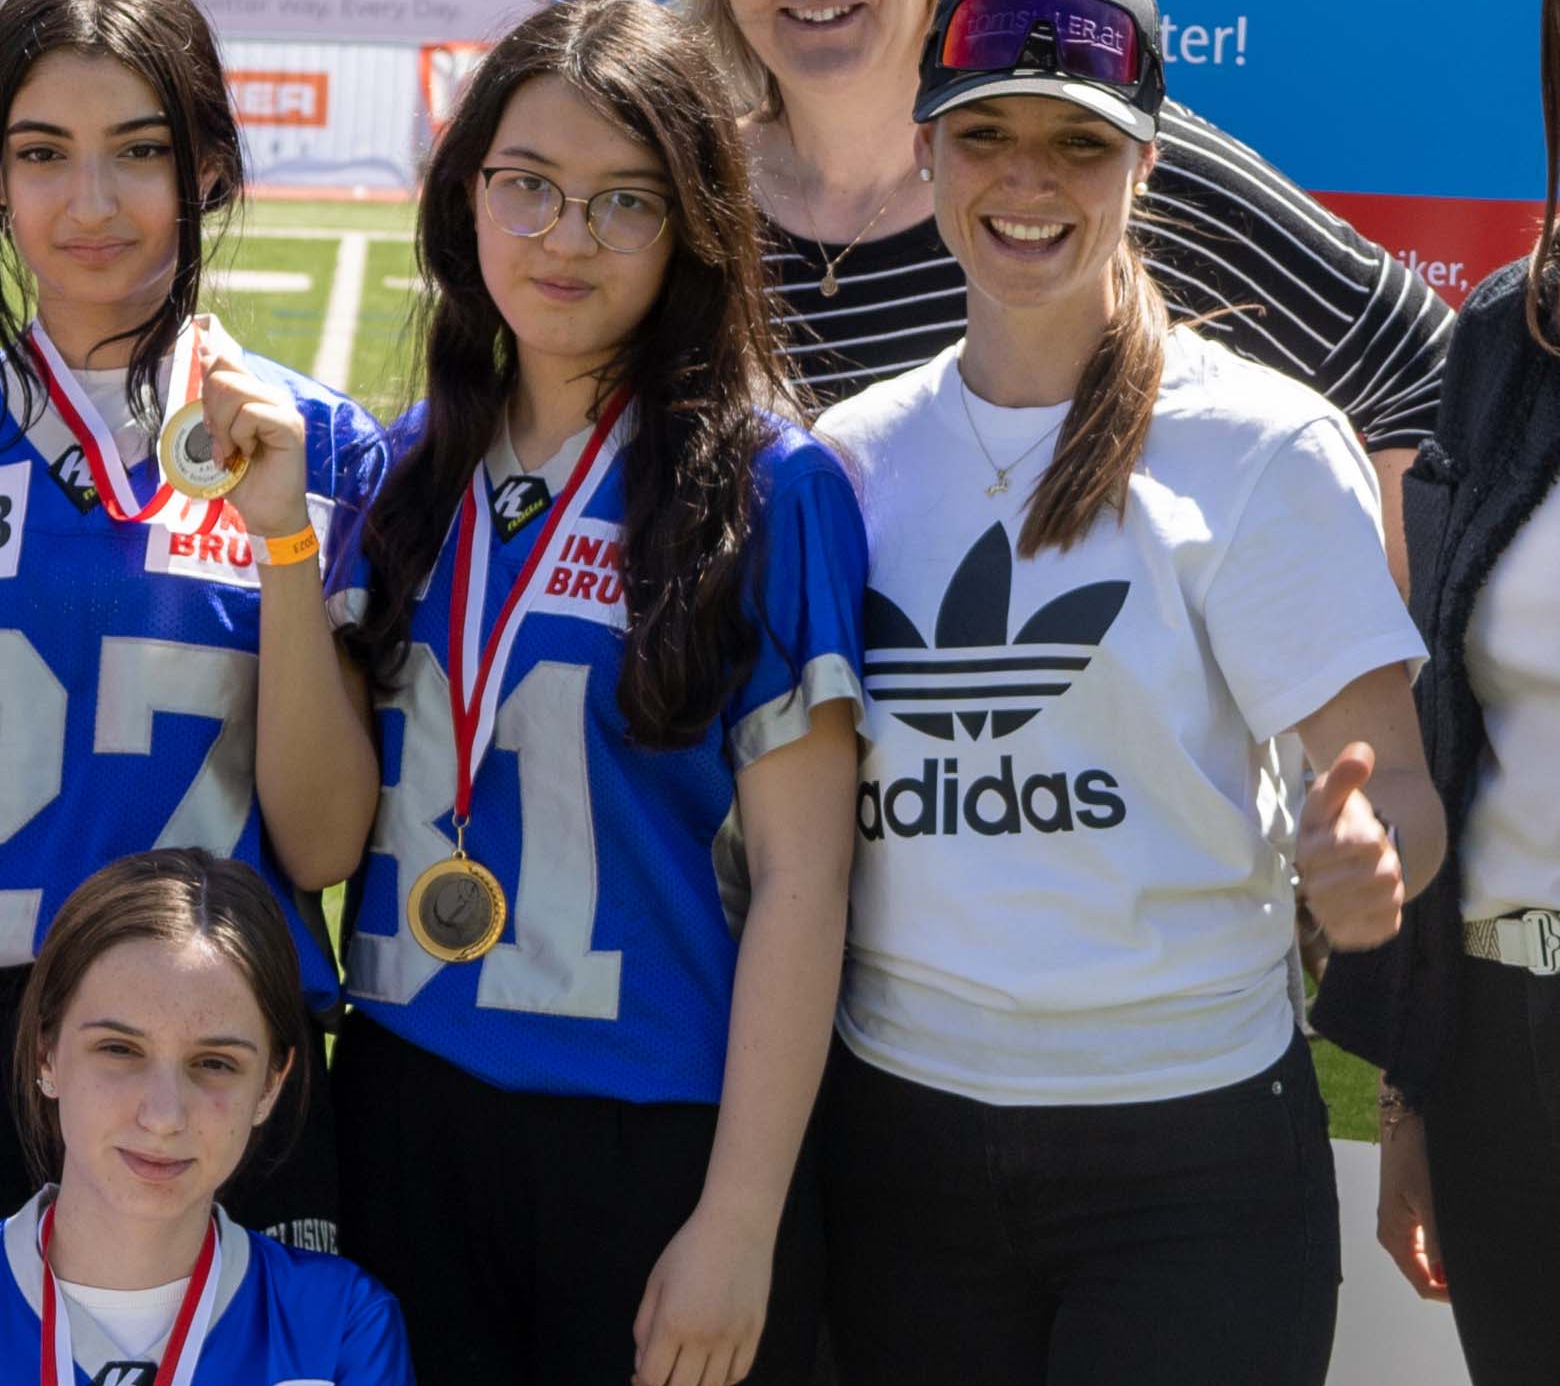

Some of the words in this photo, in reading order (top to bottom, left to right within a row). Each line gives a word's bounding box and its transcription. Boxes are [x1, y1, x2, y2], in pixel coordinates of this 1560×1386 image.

[1159, 15, 1249, 66] ter!
[168, 531, 254, 569] BRU
[558, 533, 625, 573] INN
[544, 566, 626, 606] BRU
[856, 754, 1128, 842] adidas
